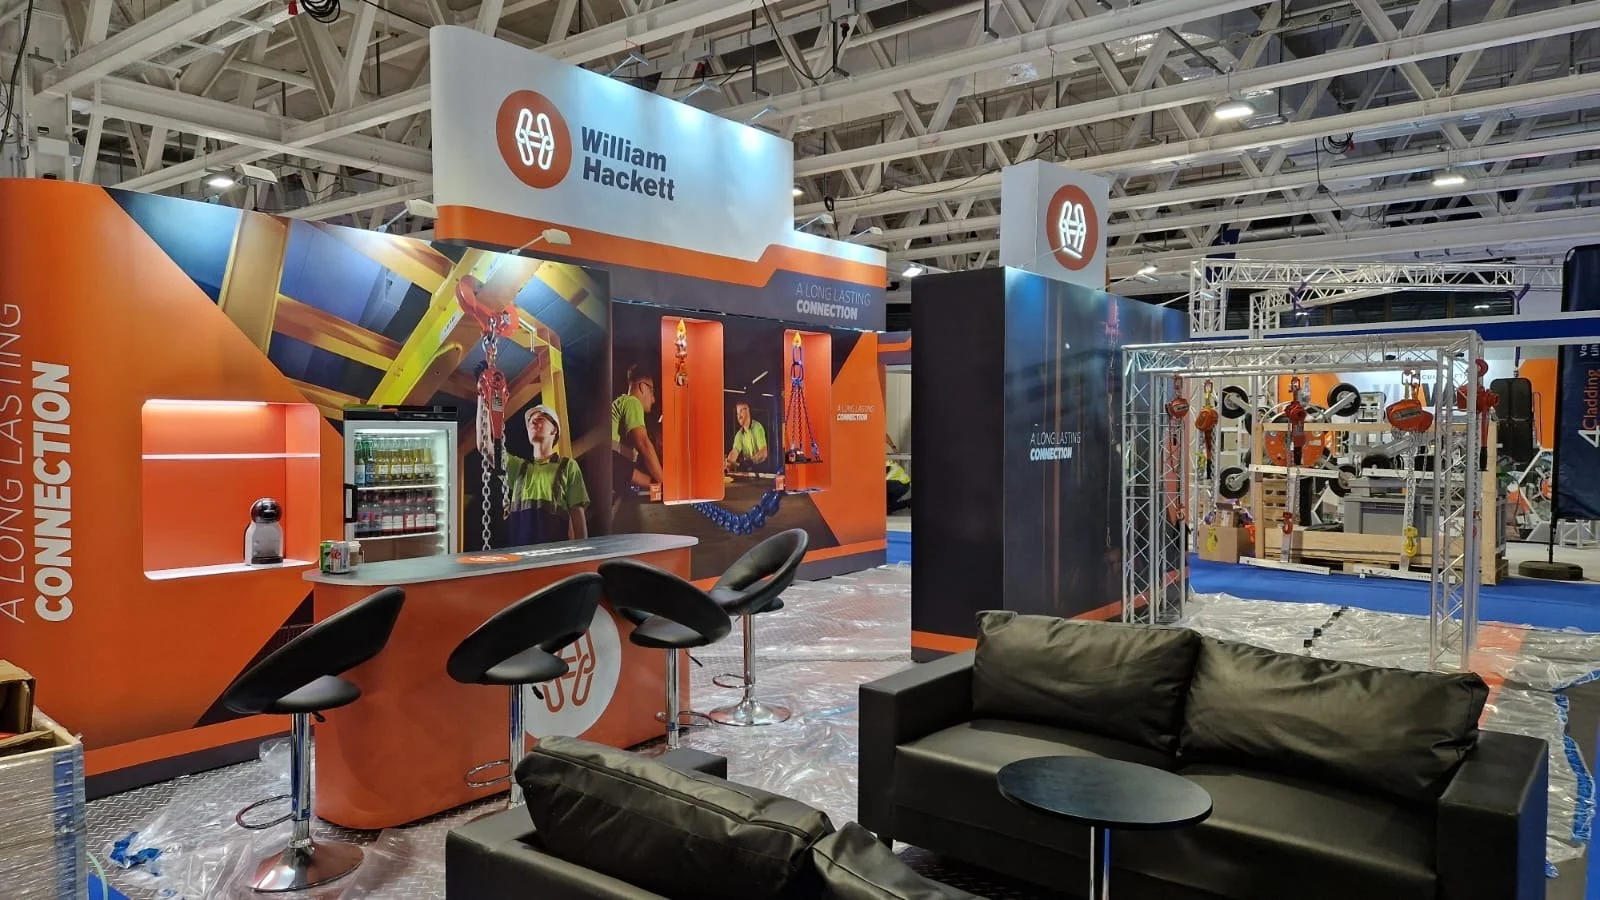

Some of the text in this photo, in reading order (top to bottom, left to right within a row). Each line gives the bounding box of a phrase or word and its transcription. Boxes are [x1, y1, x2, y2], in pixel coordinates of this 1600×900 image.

[581, 126, 667, 172] William
[583, 156, 675, 201] Hackett
[795, 283, 872, 306] A LONG LASTING
[796, 299, 858, 321] CONNECTION
[1030, 431, 1081, 446] A LONG LASTING
[1030, 447, 1073, 461] CONNECTION
[0, 304, 24, 623] A LONG LASTING
[32, 361, 73, 622] CONNECTION
